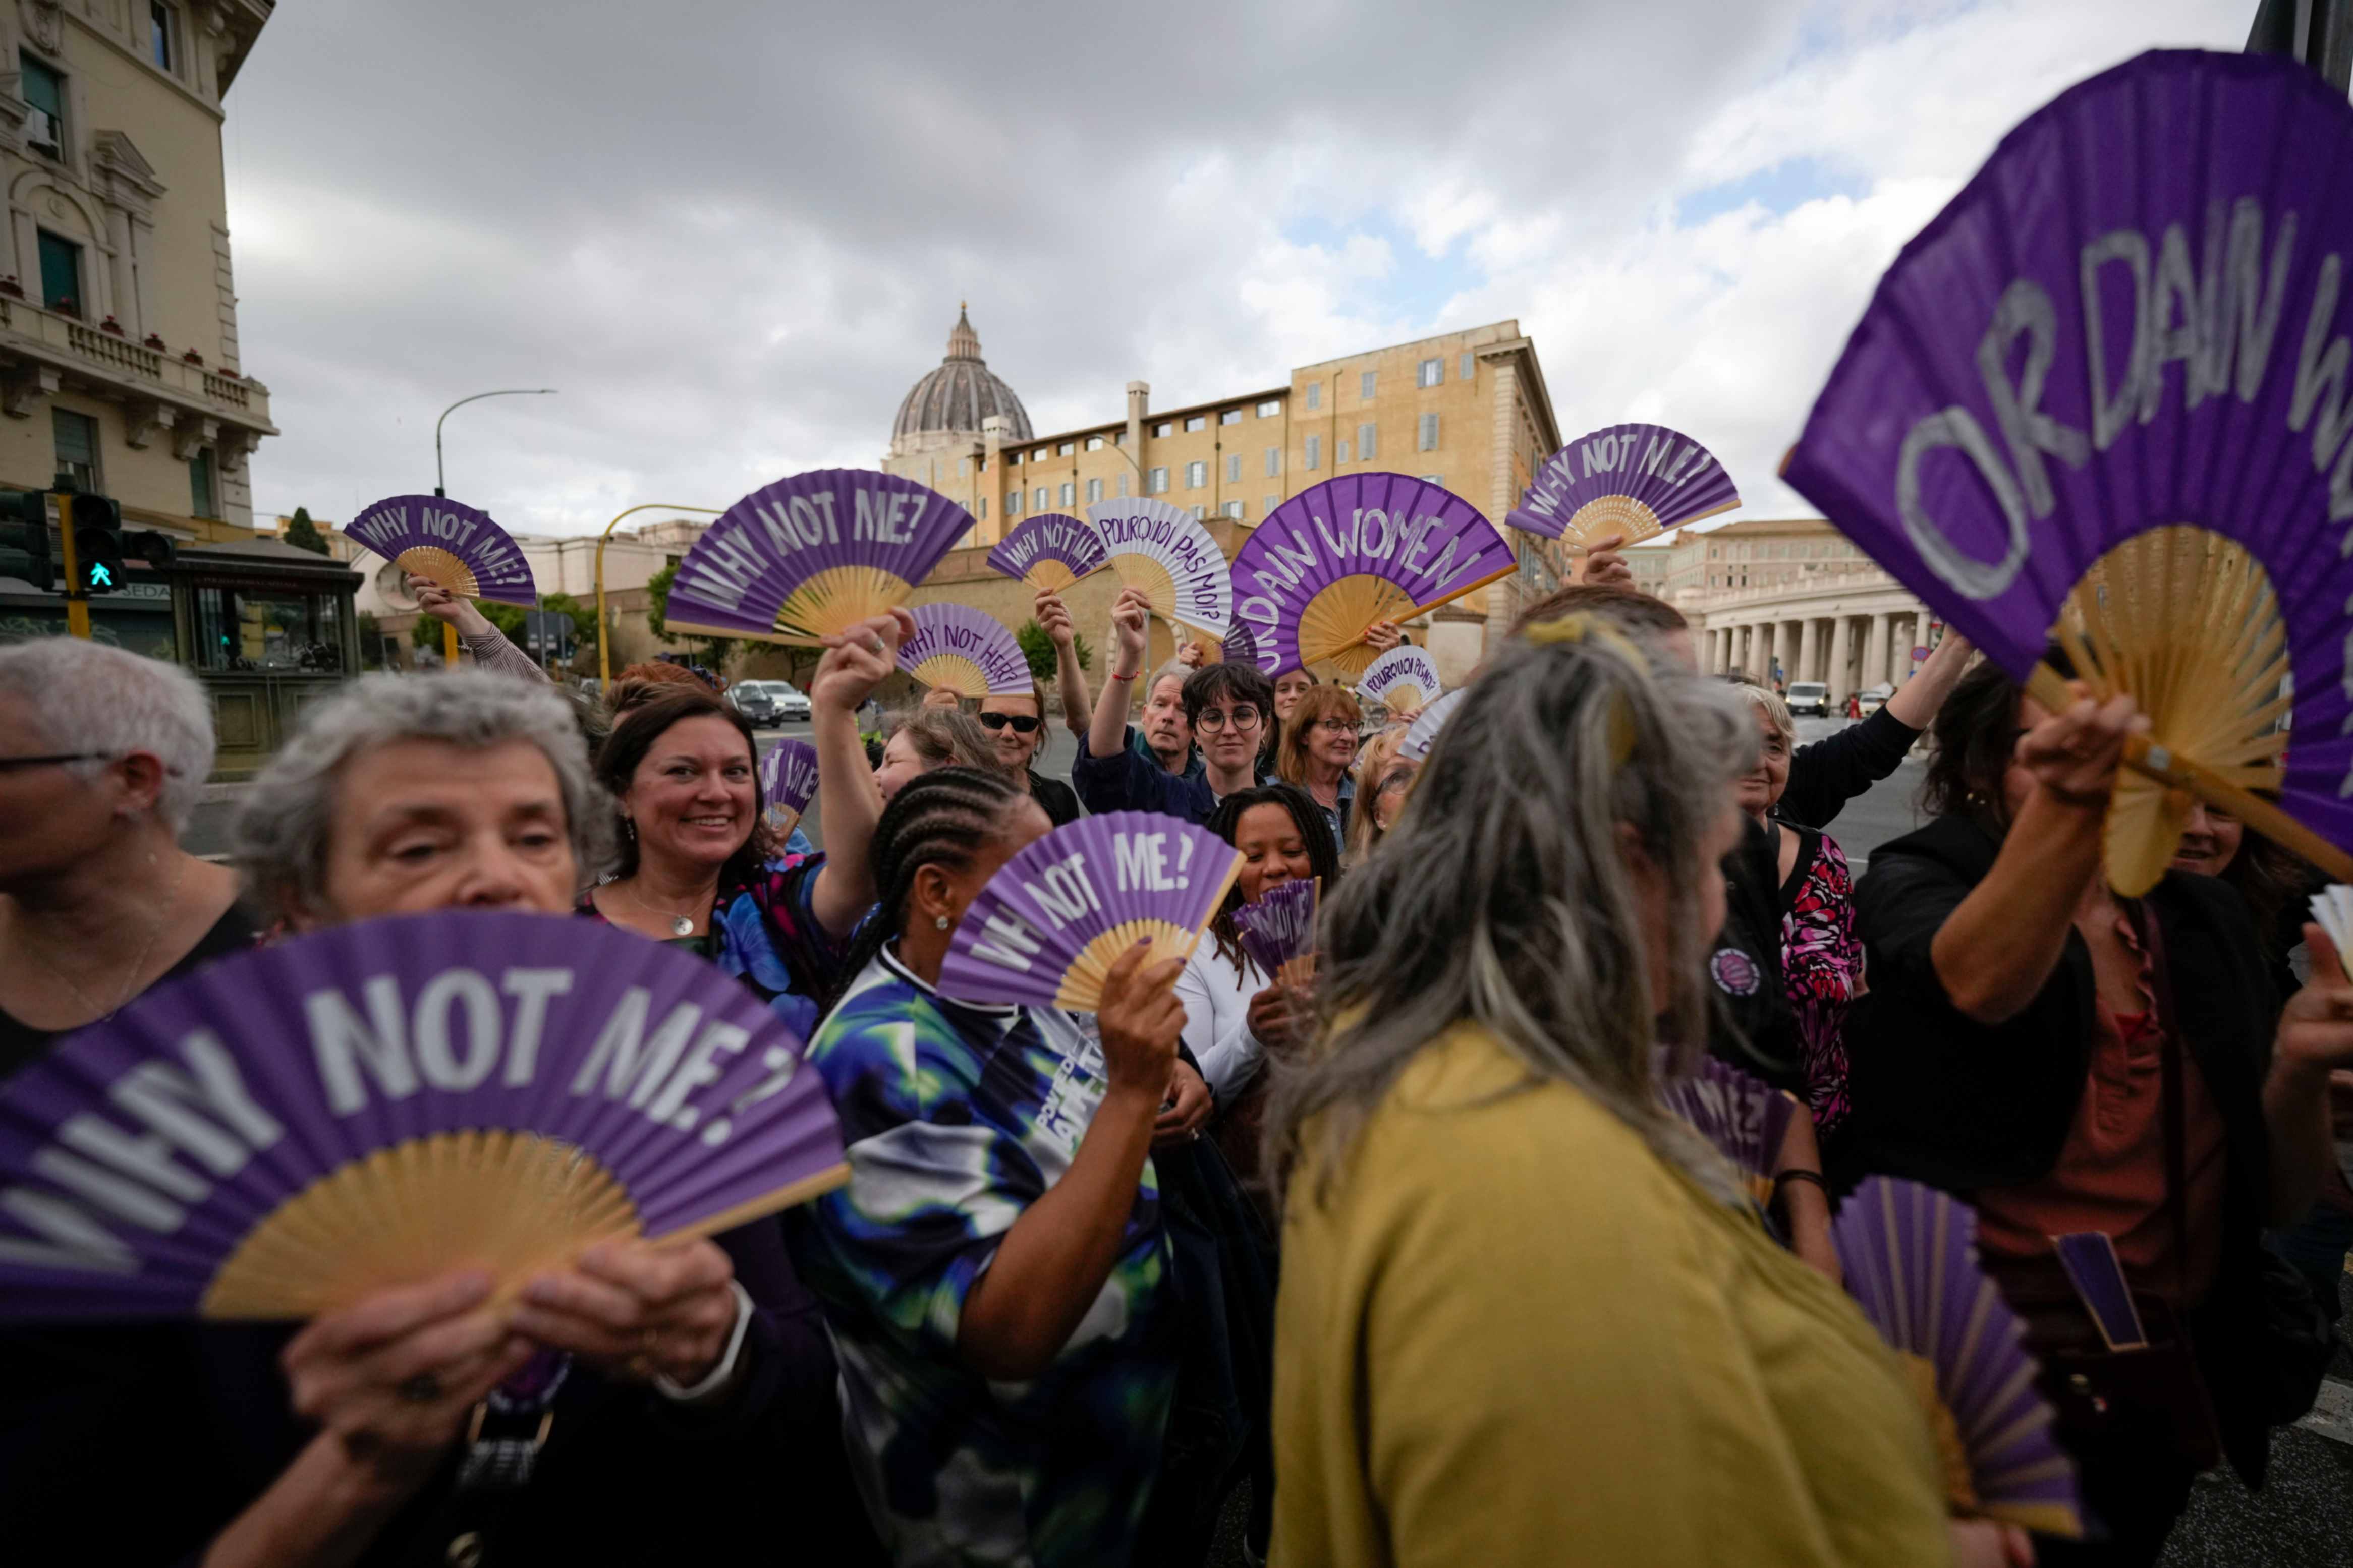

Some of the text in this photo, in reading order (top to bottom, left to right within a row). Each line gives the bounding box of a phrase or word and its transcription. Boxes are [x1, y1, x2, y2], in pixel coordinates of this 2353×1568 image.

[1896, 196, 2299, 601] ORDAIN
[1528, 433, 1712, 517] WHY NOT ME?
[360, 506, 528, 586] WHY NOT ME?
[682, 487, 929, 612] WHY NOT ME?
[1005, 529, 1038, 568] WHY
[1043, 523, 1078, 552] NOT
[1099, 515, 1220, 620] POURQUOI PAS MOI?
[1314, 507, 1482, 591] WOMEN
[898, 624, 1018, 683] WHY NOT HER?
[1366, 657, 1414, 694] POURQUOI
[1023, 851, 1101, 931] NOT
[1114, 832, 1194, 892] ME?
[0, 967, 796, 1278] WHY NOT ME?
